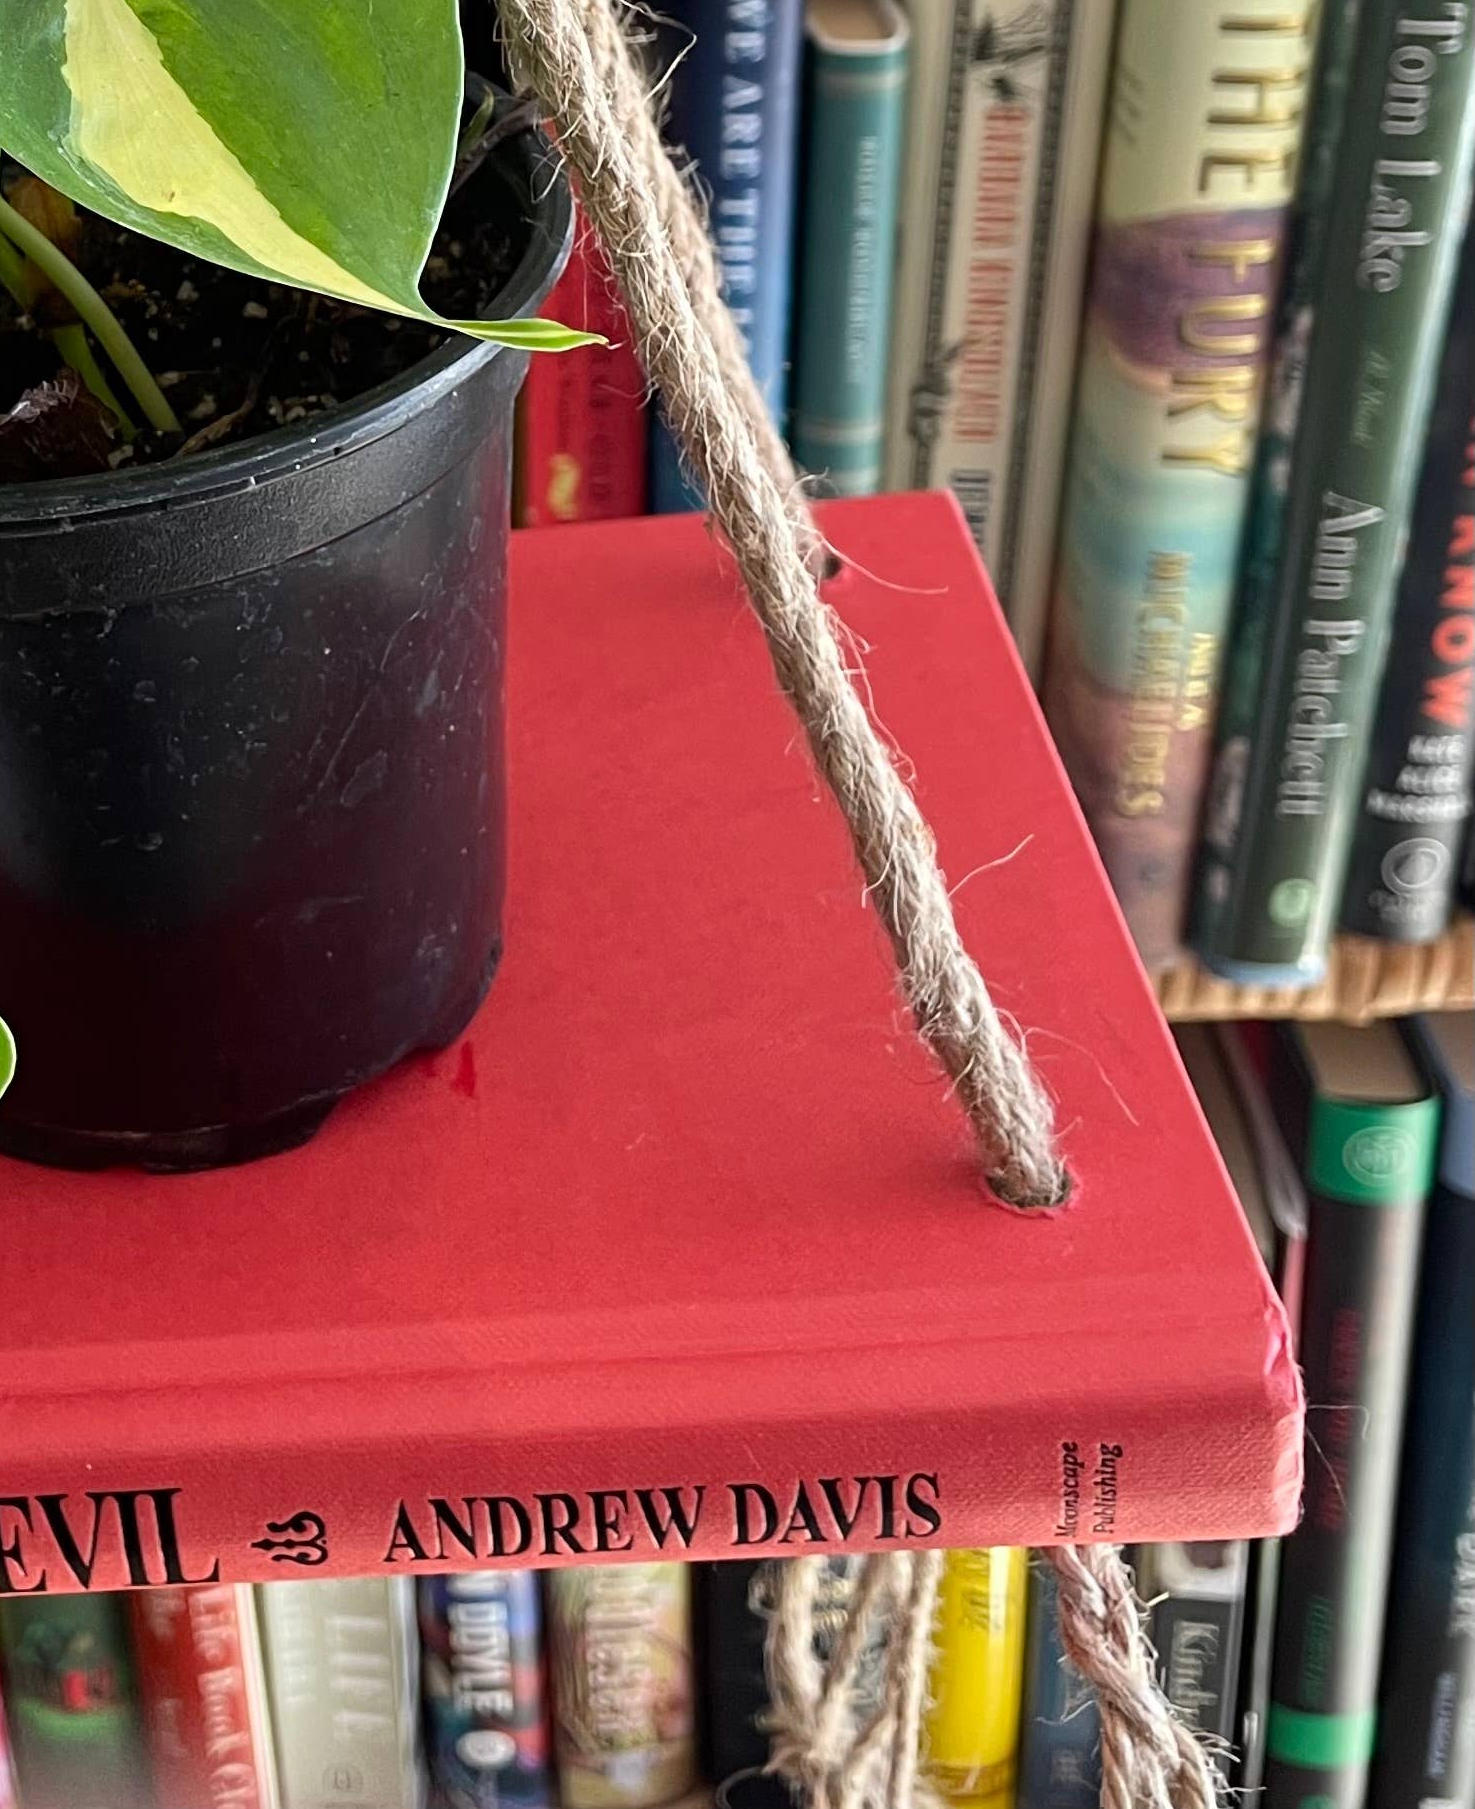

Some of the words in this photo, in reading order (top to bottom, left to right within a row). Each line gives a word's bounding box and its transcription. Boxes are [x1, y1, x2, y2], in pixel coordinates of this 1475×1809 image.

[1382, 1, 1468, 138] Tom
[720, 74, 765, 181] ARE
[717, 187, 761, 294] THE
[1355, 157, 1443, 294] Lake
[1161, 236, 1277, 475] FURY
[1318, 488, 1387, 602] Ann
[382, 1482, 710, 1565] ANDREW
[721, 1471, 943, 1545] DAVIS
[1055, 1439, 1080, 1539] Moonscape
[1092, 1441, 1123, 1535] Publishing
